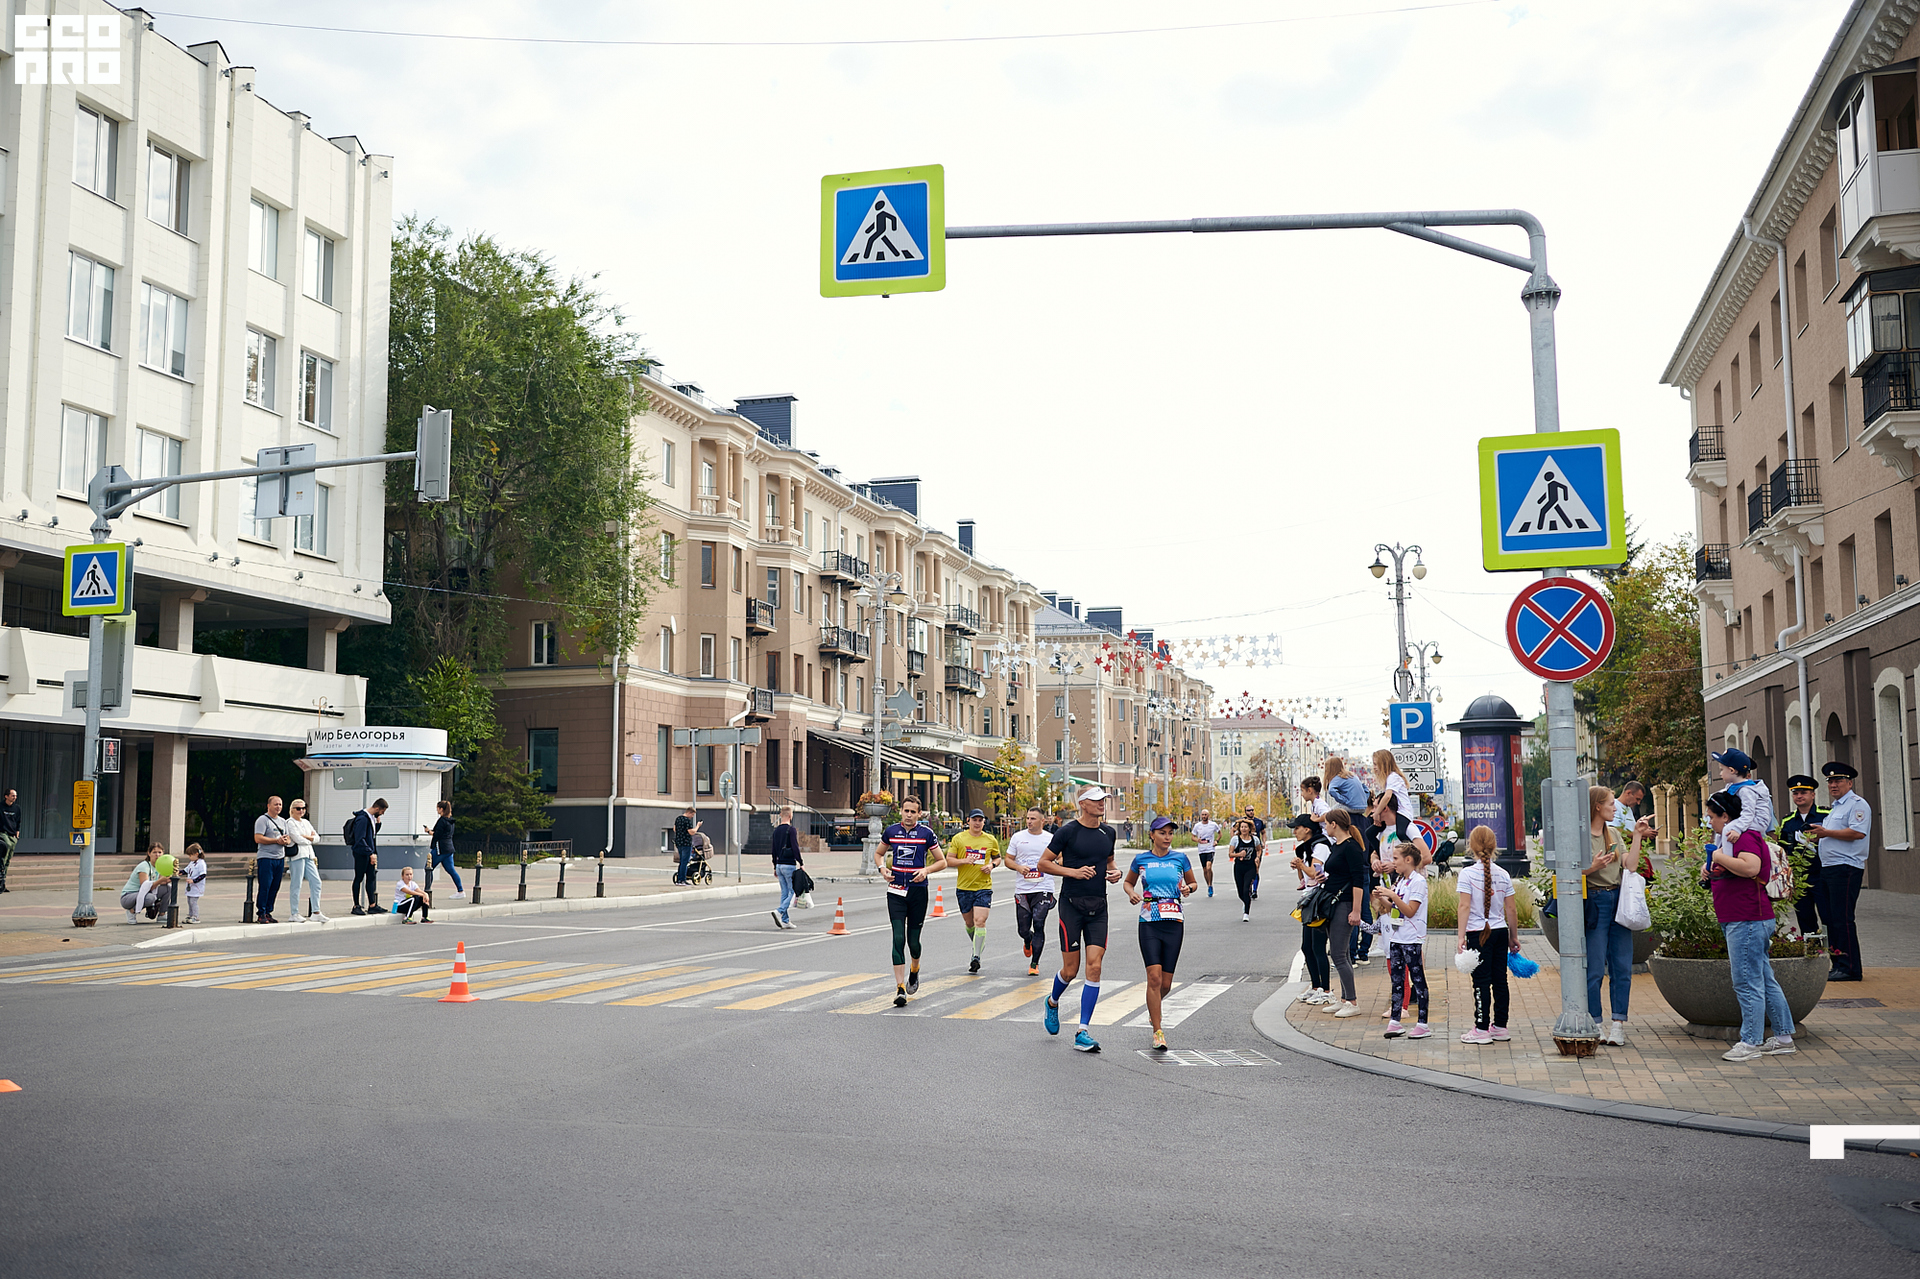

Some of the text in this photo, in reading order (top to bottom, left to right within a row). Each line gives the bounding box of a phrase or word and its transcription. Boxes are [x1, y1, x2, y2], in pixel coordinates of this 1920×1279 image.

[1401, 708, 1424, 740] P
[314, 729, 405, 742] Мир Белогорья
[1418, 753, 1428, 762] 20
[1467, 759, 1491, 782] 19
[1161, 904, 1179, 912] 2344
